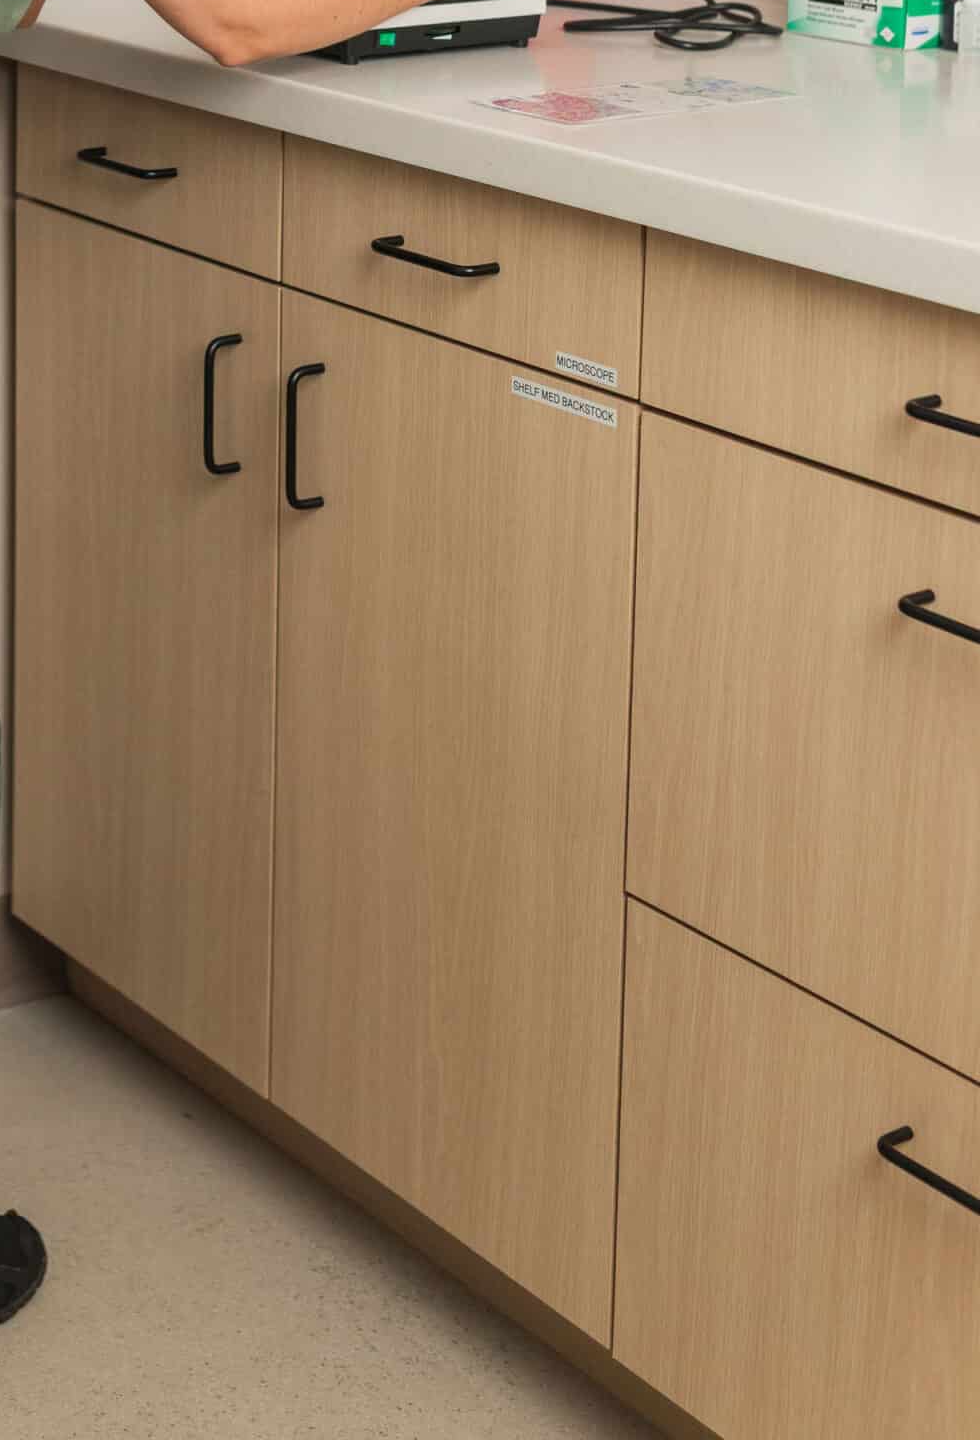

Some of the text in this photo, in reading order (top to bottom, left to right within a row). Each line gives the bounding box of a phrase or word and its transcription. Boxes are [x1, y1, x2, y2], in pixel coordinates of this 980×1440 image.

[556, 354, 615, 384] MICROSCOPE
[512, 379, 615, 423] SHELF MED BACKSTOCK
